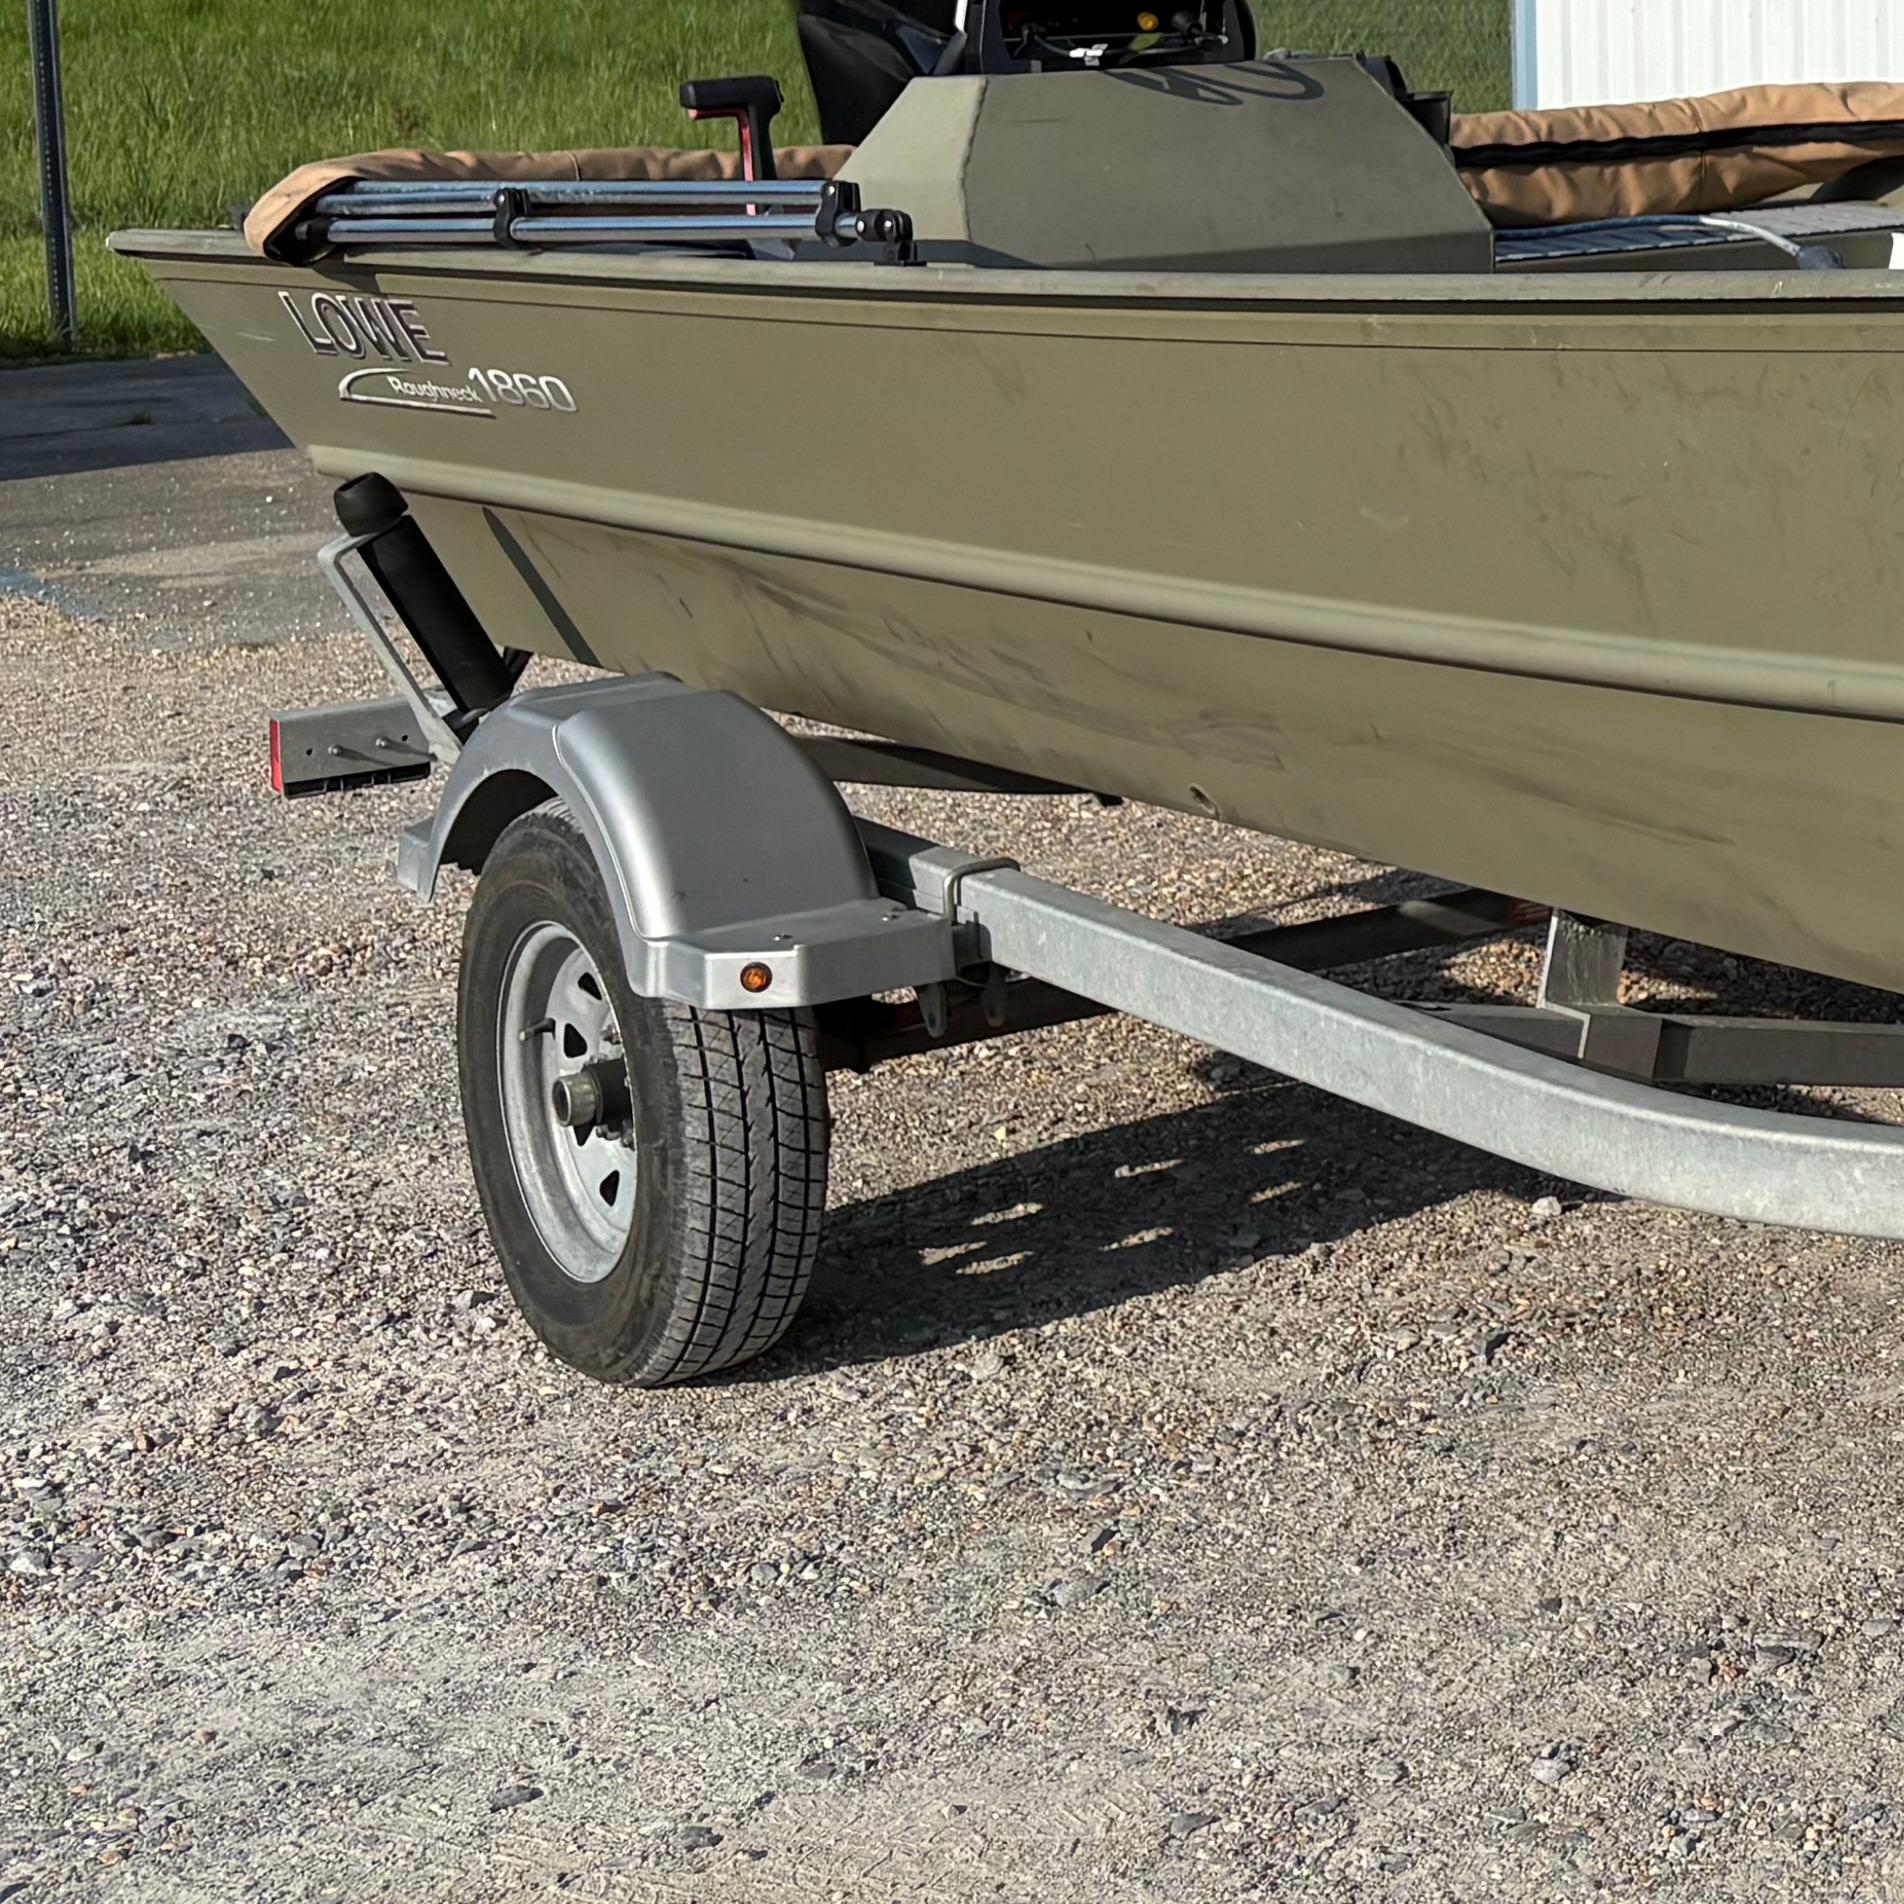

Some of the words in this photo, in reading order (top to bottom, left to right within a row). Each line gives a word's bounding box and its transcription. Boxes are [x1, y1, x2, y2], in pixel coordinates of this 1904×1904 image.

[277, 290, 452, 367] LOWE
[387, 374, 482, 406] Roughneck
[467, 366, 579, 414] 1860
